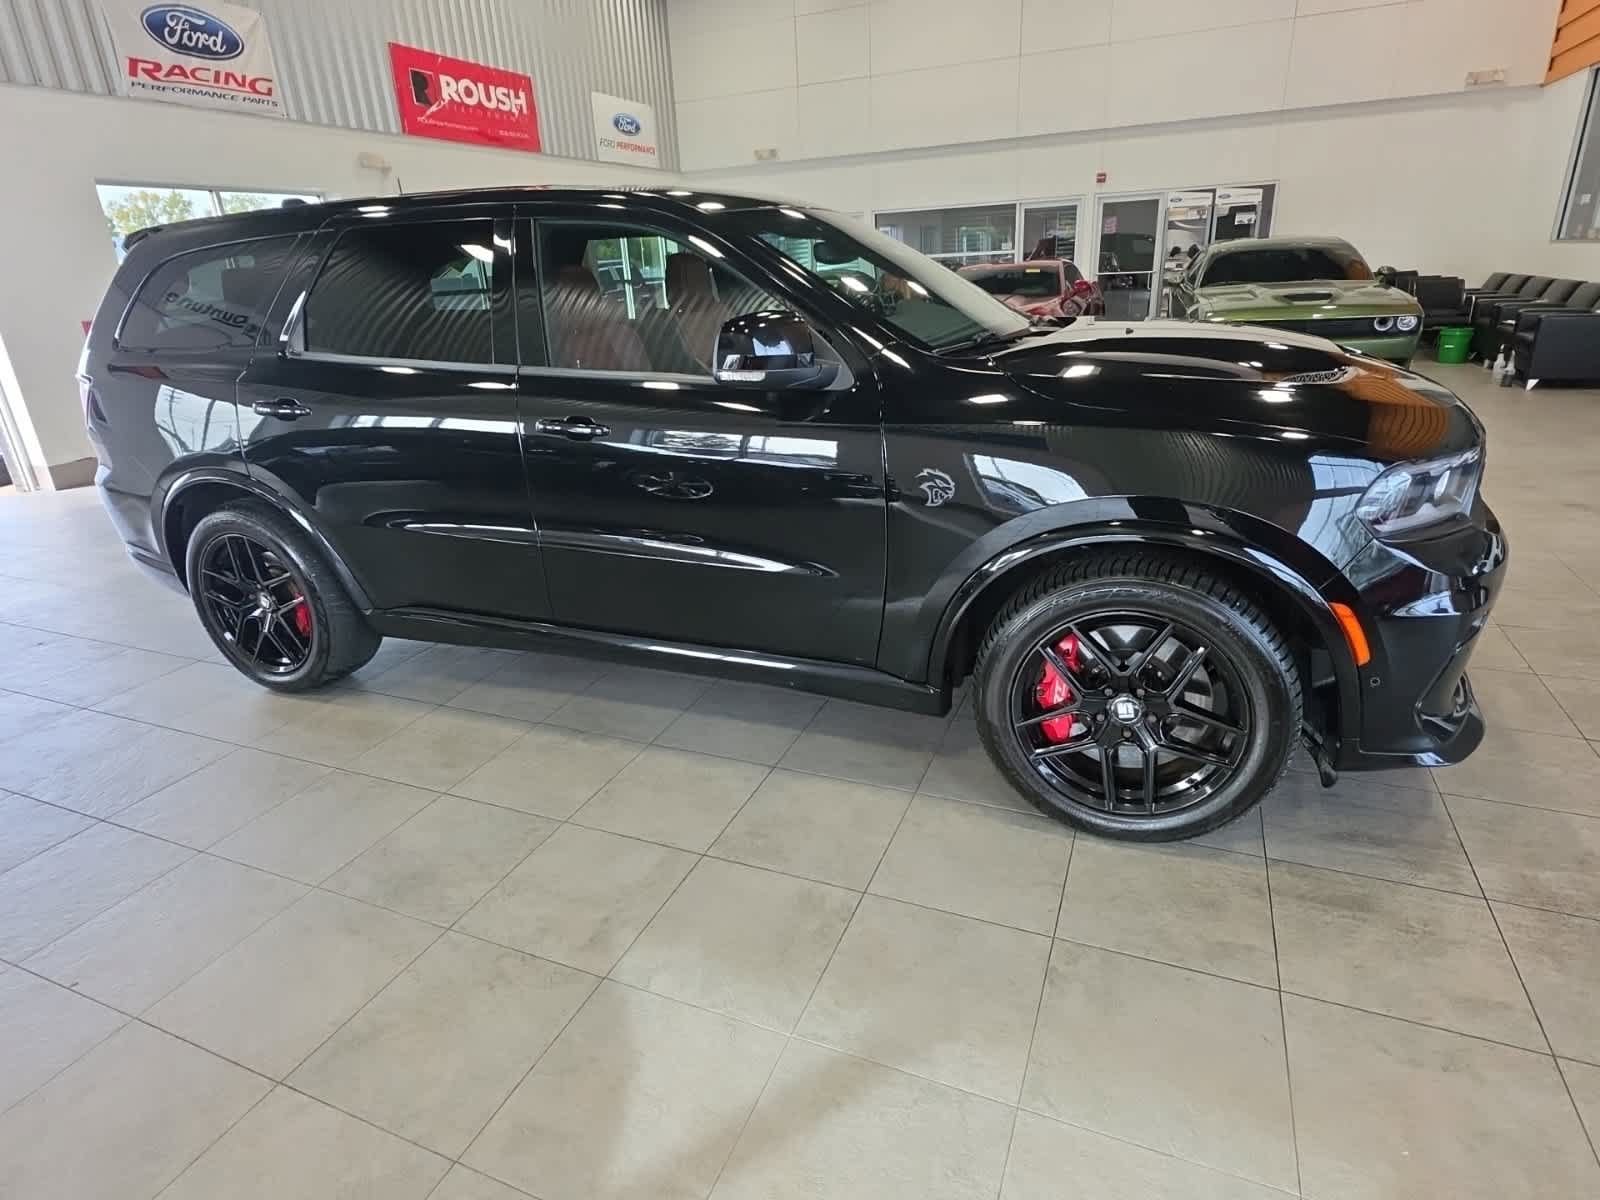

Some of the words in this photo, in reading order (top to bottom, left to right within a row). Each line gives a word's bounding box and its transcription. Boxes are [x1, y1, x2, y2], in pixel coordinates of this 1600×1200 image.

[164, 12, 227, 53] Ford
[127, 57, 273, 97] RACING
[130, 81, 238, 102] PERFORMANCE
[242, 95, 279, 108] PARTS
[438, 74, 528, 115] ROUSH
